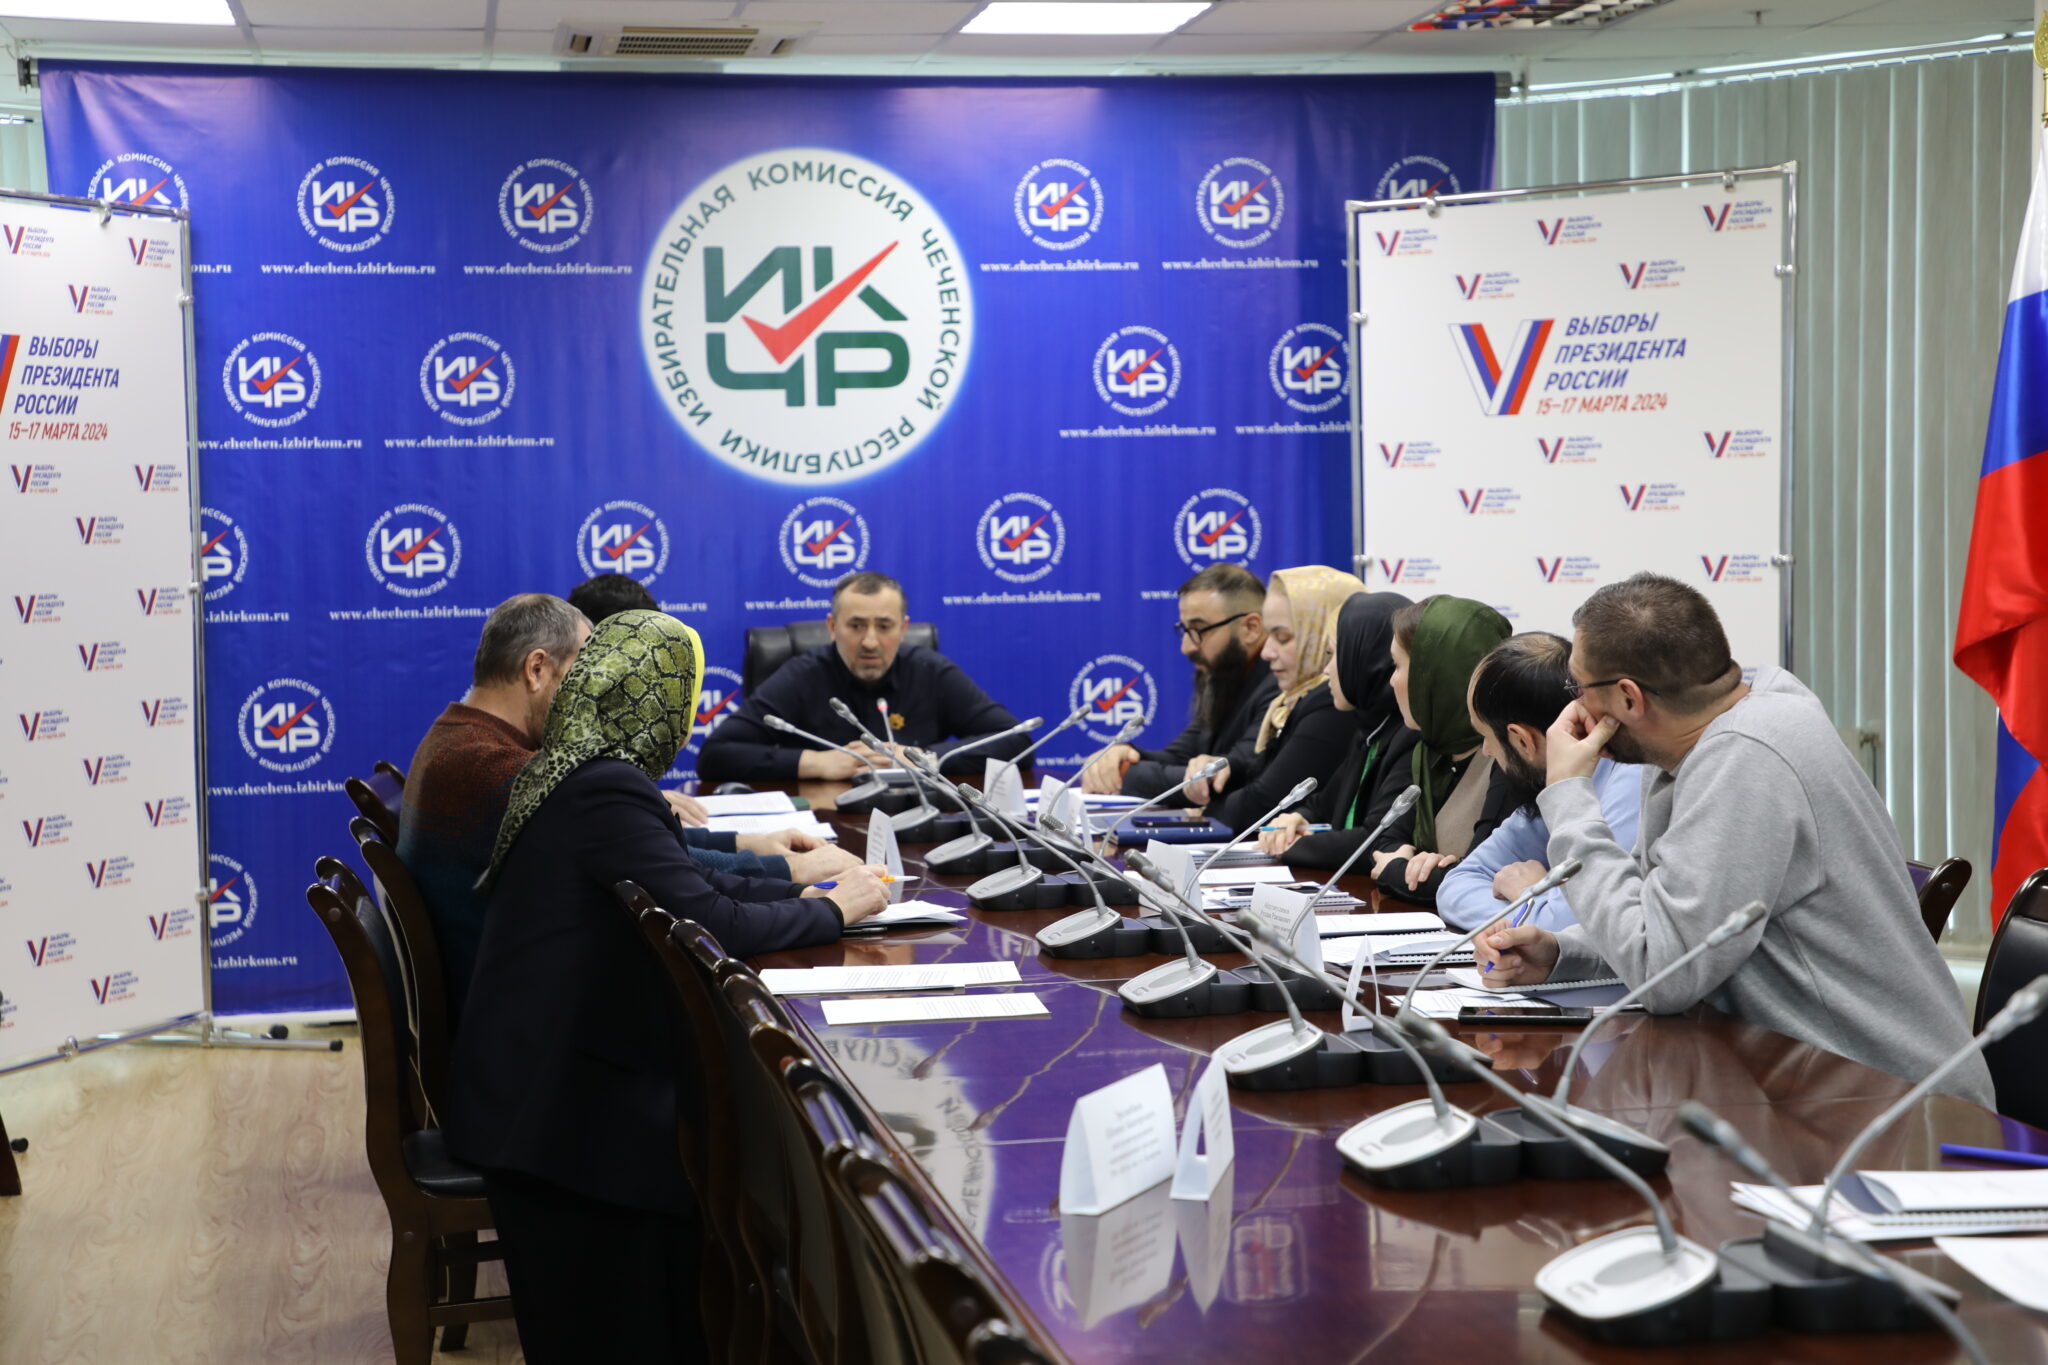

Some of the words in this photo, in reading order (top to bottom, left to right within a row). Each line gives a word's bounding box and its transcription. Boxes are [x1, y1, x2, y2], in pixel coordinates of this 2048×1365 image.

[117, 153, 173, 174] КОМИССИЯ
[747, 161, 914, 222] КОМИССИЯ
[703, 244, 908, 323] ИК
[653, 184, 735, 426] ИЗБИРАТЕЛЬНАЯ
[917, 227, 962, 411] ЧЕЧЕНСКОЙ
[1564, 312, 1659, 336] ВЫБОРЫ
[28, 336, 99, 359] ВЫБОРЫ
[1554, 338, 1687, 364] ПРЕЗИДЕНТА
[21, 365, 120, 390] ПРЕЗИДЕНТА
[1544, 368, 1629, 392] РОССИИ
[13, 394, 79, 415] РОССИИ
[1578, 394, 1629, 413] МАРТА
[1631, 392, 1668, 411] 2024
[41, 422, 80, 440] МАРТА
[81, 423, 108, 440] 2024
[197, 437, 362, 449] ww.chechen.izbirkom.ru
[719, 416, 916, 475] РЕСПУБЛИКИ
[201, 530, 231, 556] К
[202, 555, 233, 582] Р
[329, 605, 494, 620] www.chechen.izbirkom.r
[210, 877, 241, 903] К
[210, 902, 242, 928] Р
